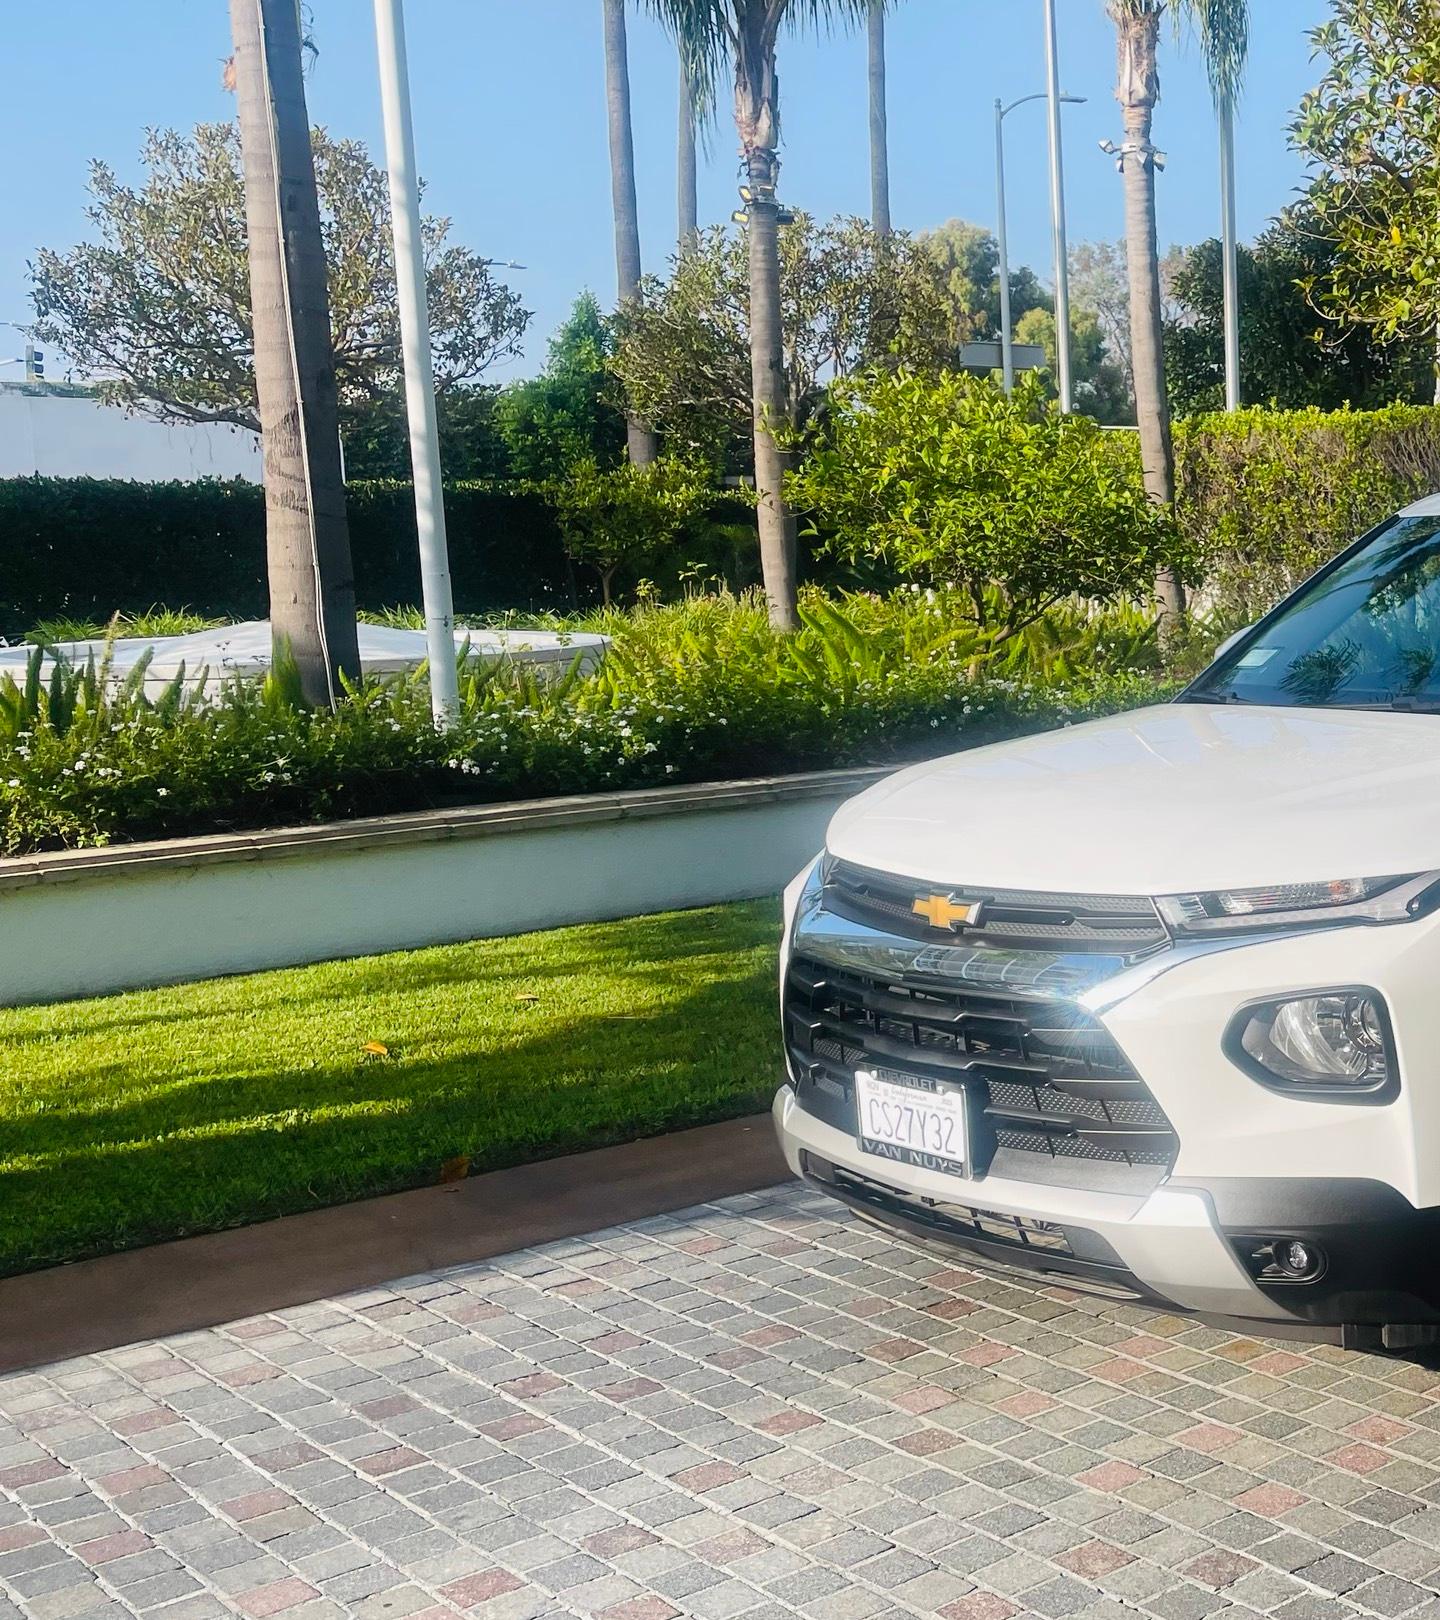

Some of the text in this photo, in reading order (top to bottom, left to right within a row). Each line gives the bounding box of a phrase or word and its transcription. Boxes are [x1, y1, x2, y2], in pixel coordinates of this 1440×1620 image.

[879, 1069, 934, 1091] CHEVROLET
[869, 1098, 956, 1155] CS27Y32
[863, 1140, 962, 1176] VAN NUYS
